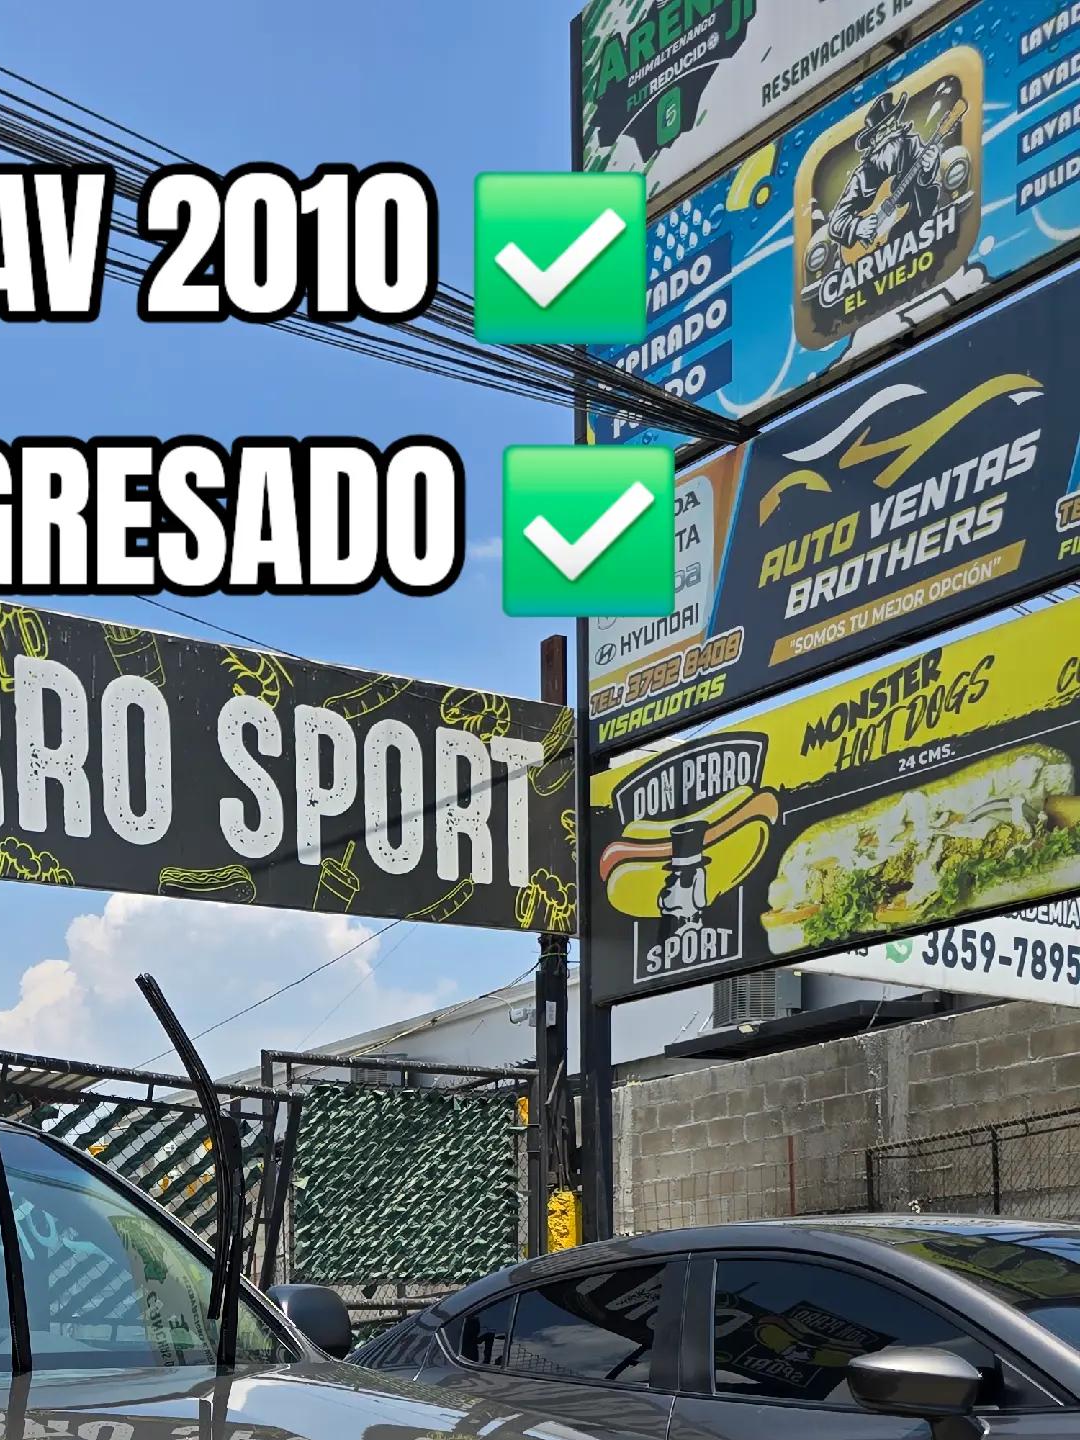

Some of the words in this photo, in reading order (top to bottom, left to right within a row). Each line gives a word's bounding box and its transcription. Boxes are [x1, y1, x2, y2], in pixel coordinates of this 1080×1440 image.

[761, 3, 887, 108] RESERVACIONES
[820, 206, 956, 305] CARWASH
[844, 292, 867, 315] EL
[873, 251, 933, 296] VIEJO
[758, 511, 860, 589] AUTO
[869, 428, 1041, 539] VENTAS
[784, 492, 1008, 620] BROTHERS
[620, 602, 699, 656] HYUNDAI
[849, 611, 870, 632] TU
[871, 588, 924, 625] MEJOR
[625, 657, 681, 703] 3792
[683, 628, 743, 675] 8408
[800, 646, 943, 757] MONSTER
[904, 654, 995, 742] DOGS
[598, 672, 727, 744] VISACUOTAS
[216, 693, 547, 890] SPORT
[633, 766, 675, 821] DON
[682, 750, 751, 806] PERRO
[898, 754, 916, 773] 24
[918, 743, 956, 765] CMS.
[646, 927, 733, 974] SPORT
